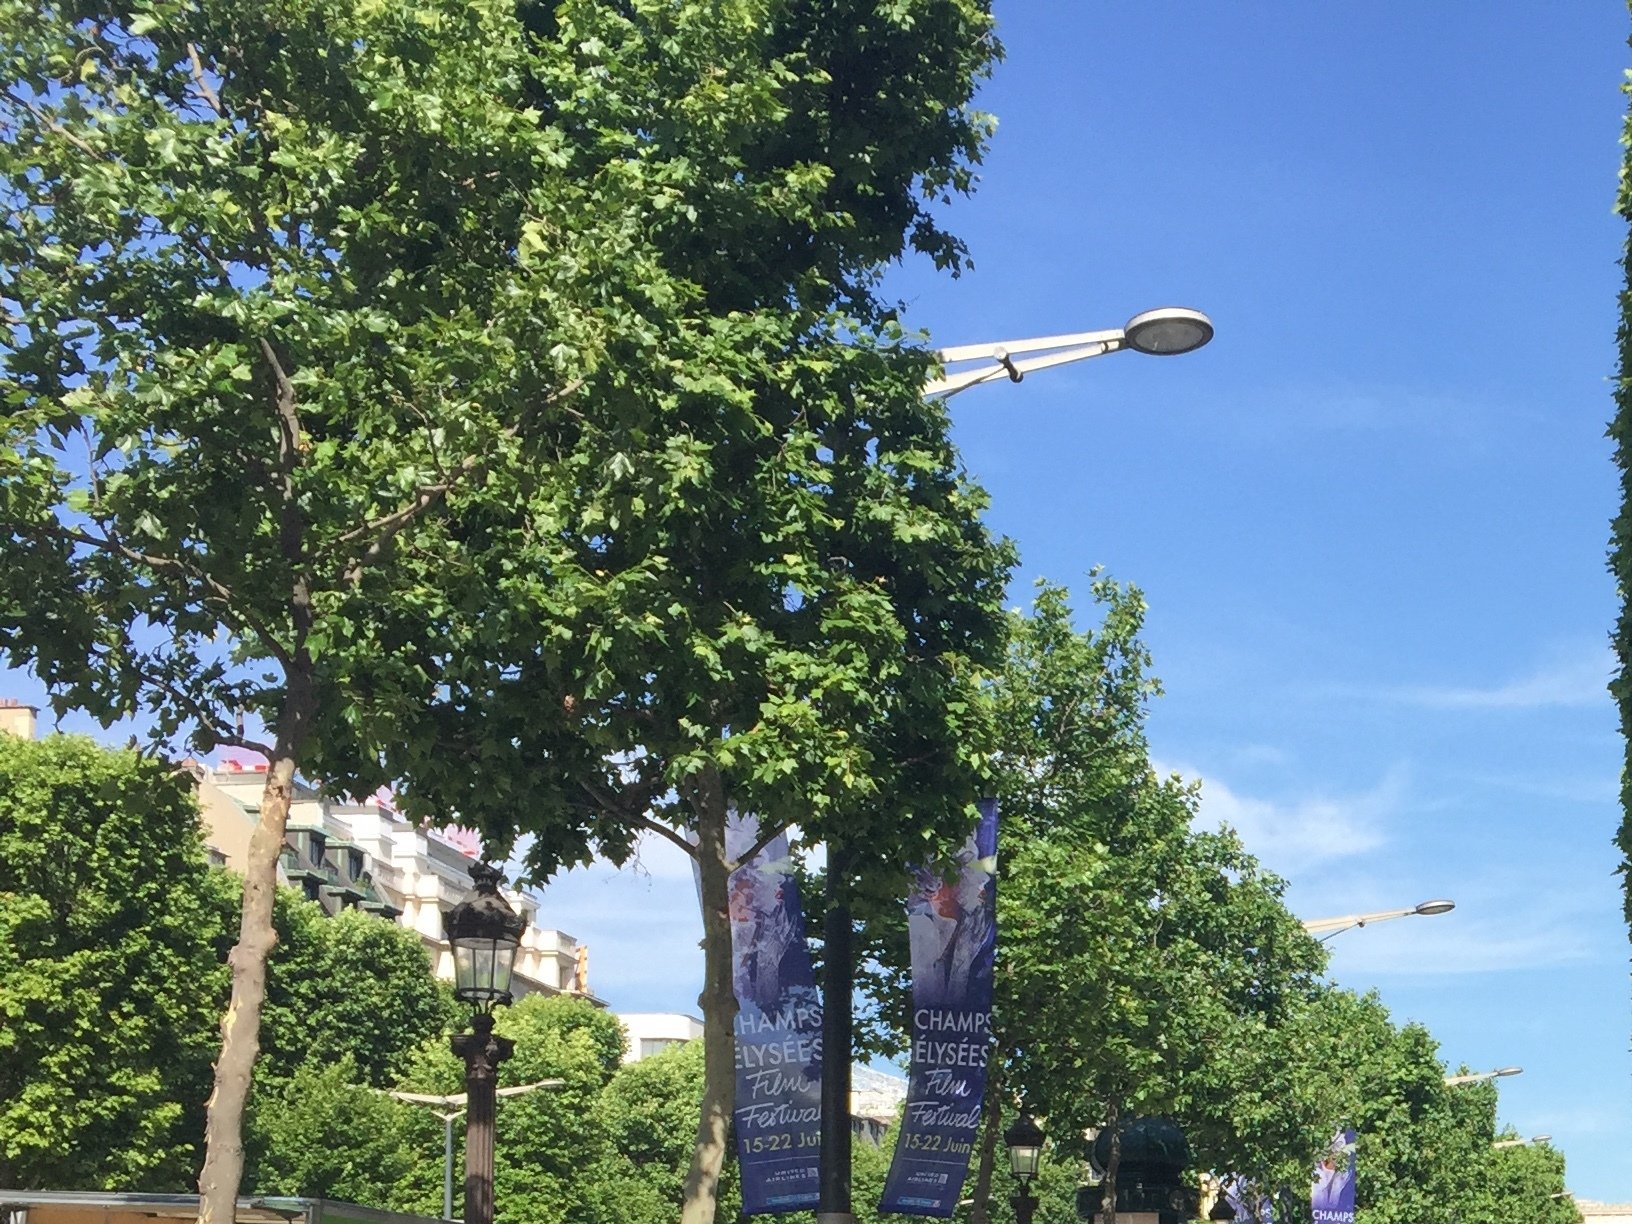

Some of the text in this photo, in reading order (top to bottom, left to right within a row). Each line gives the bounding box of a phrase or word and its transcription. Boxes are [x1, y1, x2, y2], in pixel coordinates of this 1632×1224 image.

[735, 1009, 822, 1035] HAMPS
[914, 1009, 991, 1033] CHAMPS
[915, 1035, 988, 1068] ÉLYSÉES
[745, 1069, 811, 1098] Film
[925, 1068, 971, 1097] Film
[908, 1101, 981, 1129] Festival
[744, 1130, 821, 1154] 15-22 Jui
[905, 1133, 970, 1154] 15-22 Juin
[1312, 1209, 1354, 1223] CHAMPS
